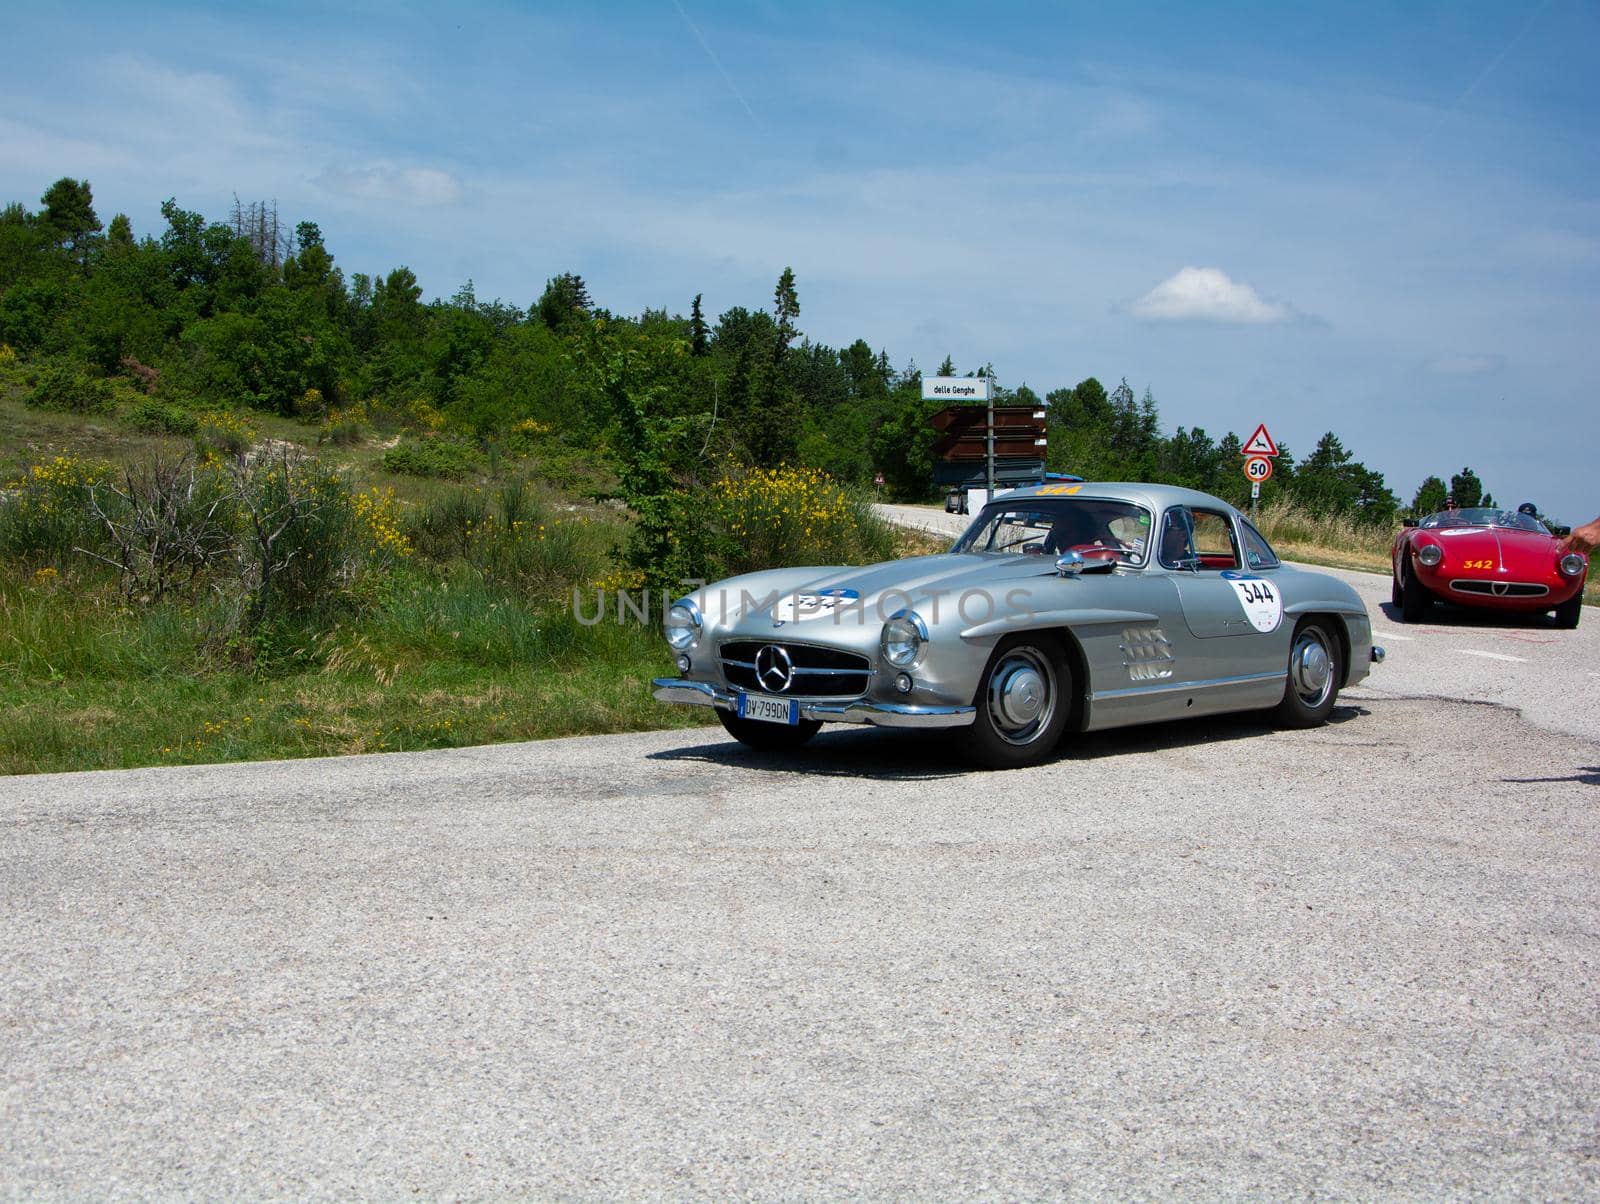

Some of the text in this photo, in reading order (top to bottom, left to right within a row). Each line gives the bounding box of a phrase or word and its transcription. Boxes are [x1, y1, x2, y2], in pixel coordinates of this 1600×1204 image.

[933, 385, 976, 396] delle Genghe
[1250, 463, 1266, 476] 50
[1463, 560, 1493, 569] 342
[1238, 582, 1274, 604] 344
